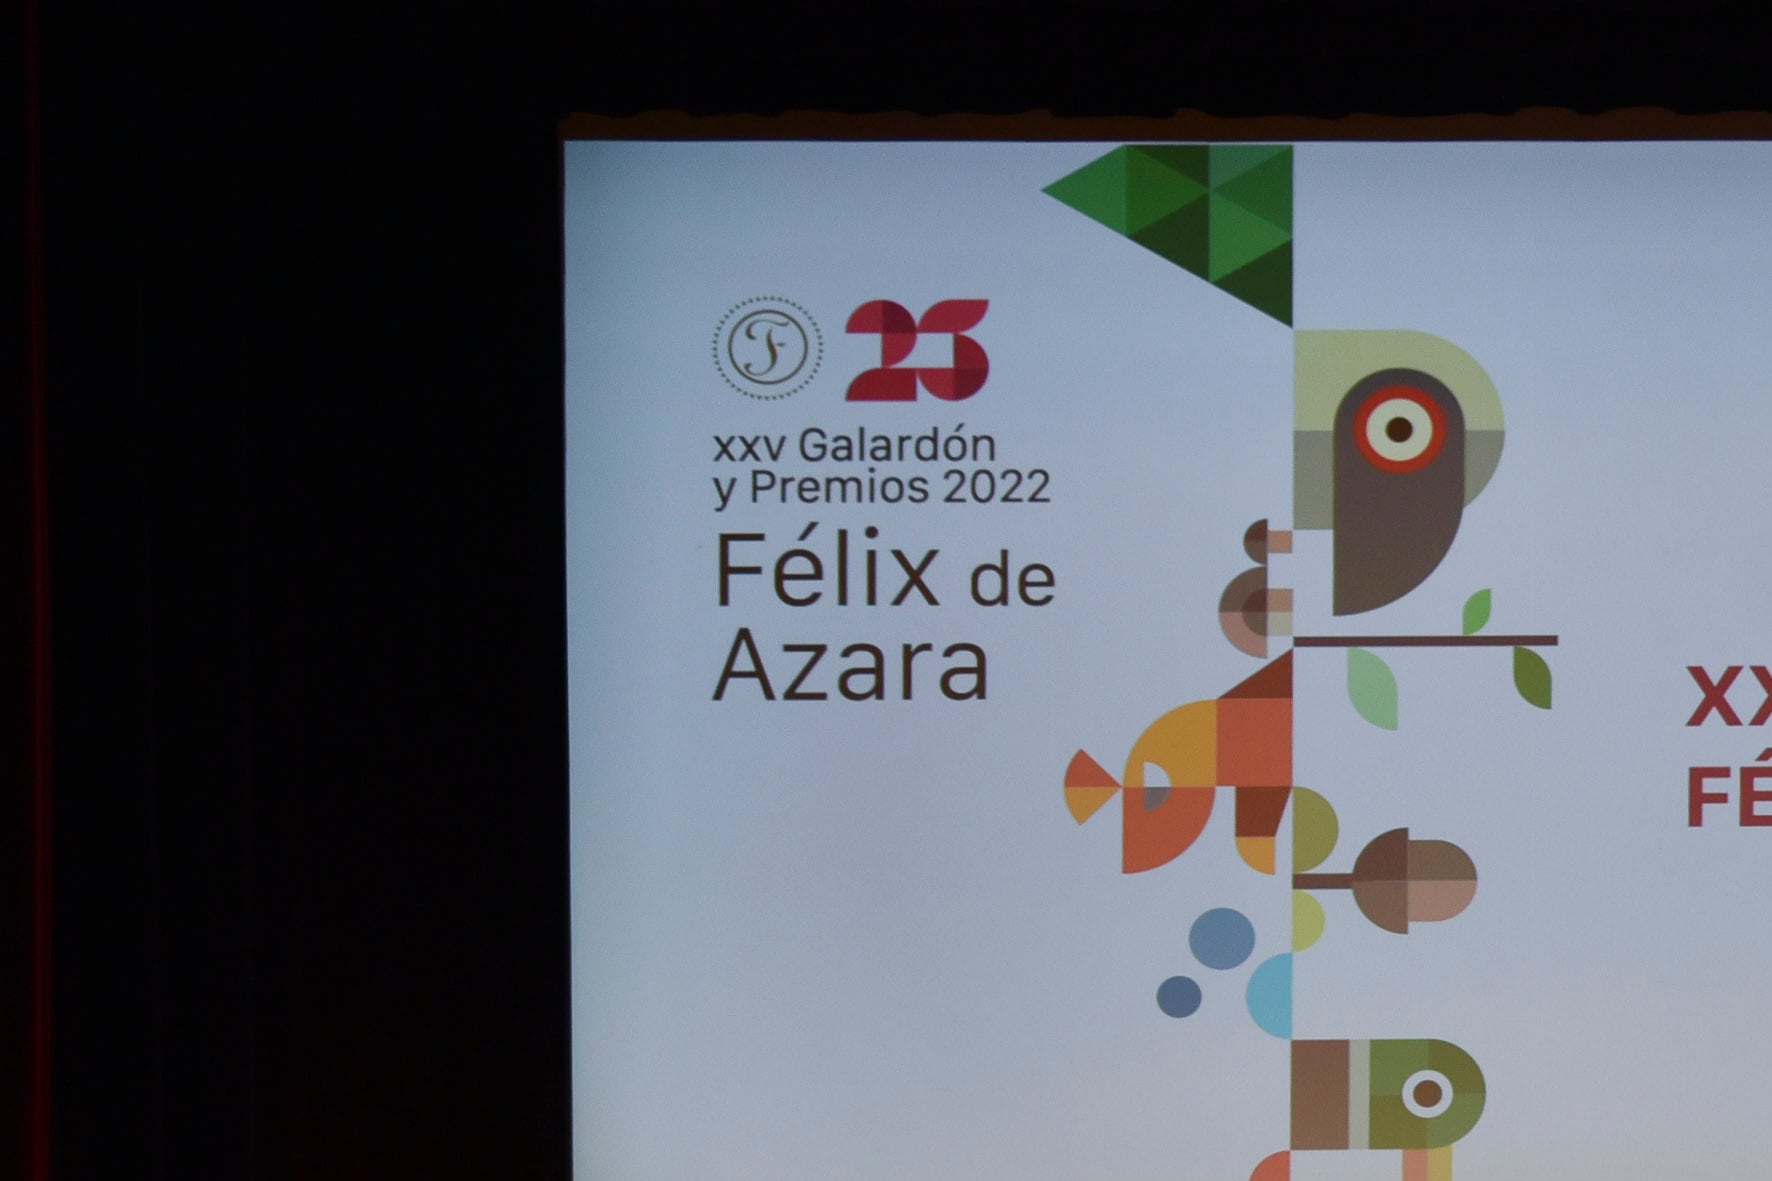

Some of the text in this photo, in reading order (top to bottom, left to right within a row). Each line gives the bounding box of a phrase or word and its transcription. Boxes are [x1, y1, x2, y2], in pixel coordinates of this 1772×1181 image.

[799, 422, 996, 462] Galardón
[712, 467, 1051, 512] y Premios 2022
[717, 521, 1056, 608] Félix de
[712, 627, 988, 702] Azara
